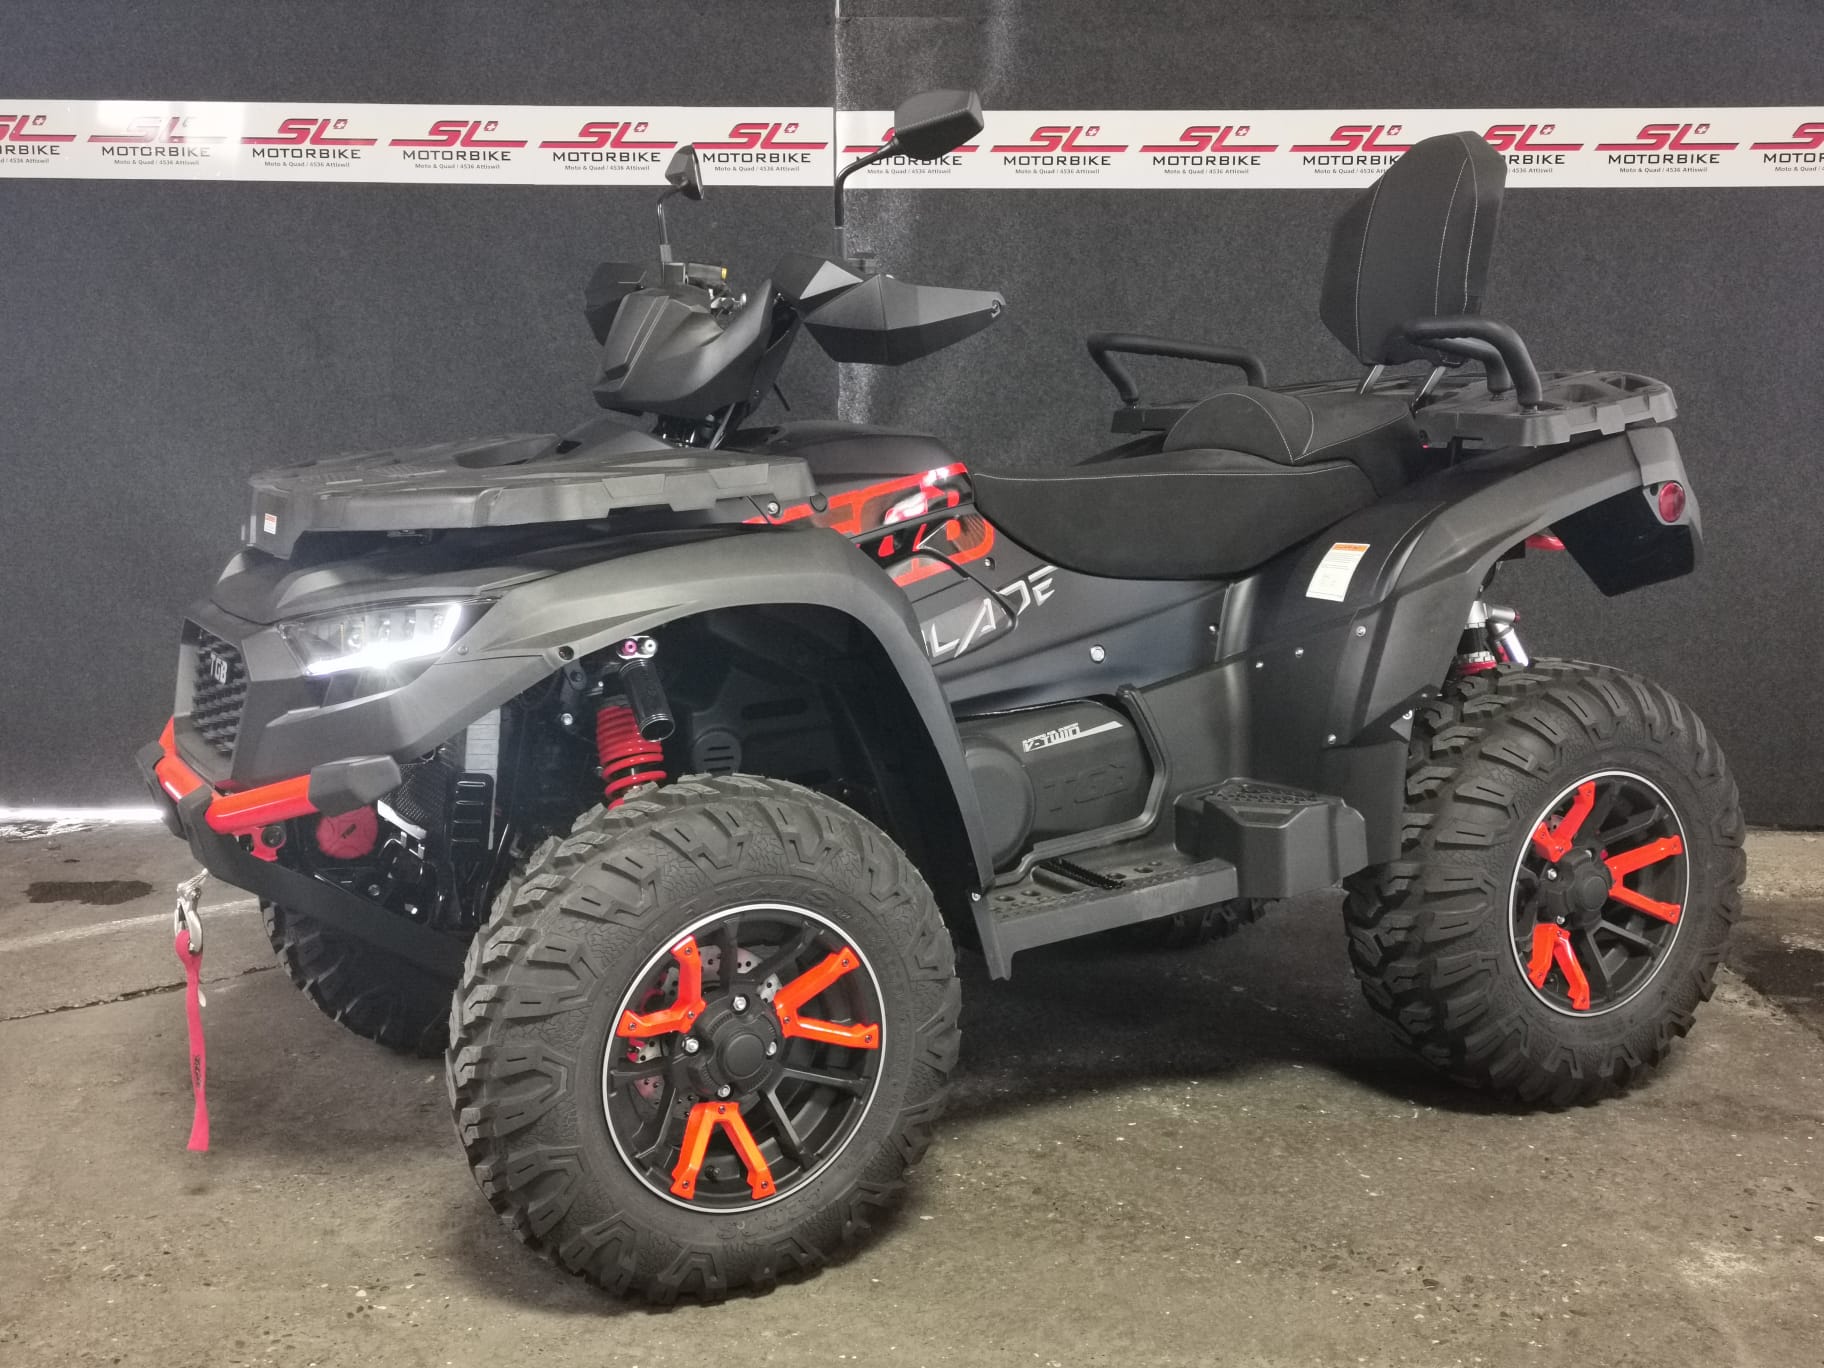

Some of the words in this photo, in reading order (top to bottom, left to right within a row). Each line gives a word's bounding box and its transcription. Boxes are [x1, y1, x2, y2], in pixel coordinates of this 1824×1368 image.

[102, 146, 210, 157] MOTORBIKE
[252, 148, 361, 159] MOTORBIKE
[403, 150, 511, 161] MOTORBIKE
[553, 152, 661, 162] MOTORBIKE
[703, 153, 811, 163] MOTORBIKE
[1004, 155, 1111, 166] MOTORBIKE
[1153, 155, 1261, 166] MOTORBIKE
[1303, 155, 1400, 166] MOTORBIK
[1609, 153, 1720, 164] MOTORBIKE
[922, 566, 1058, 658] LADE
